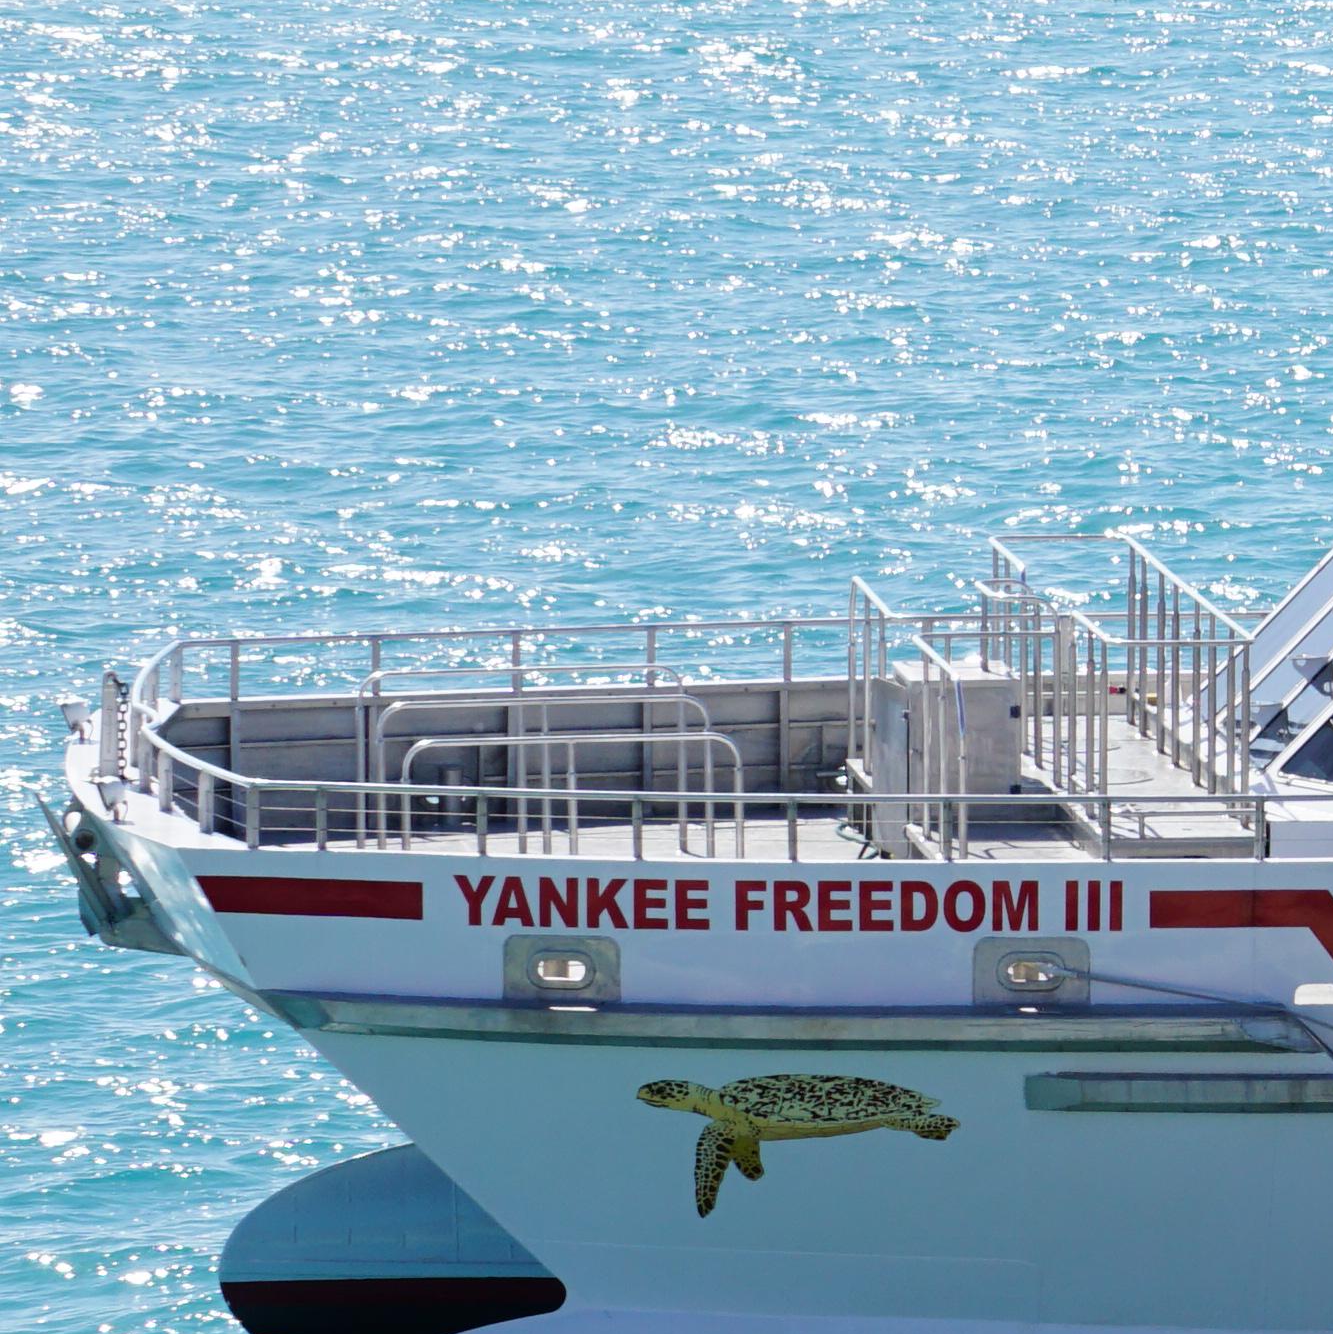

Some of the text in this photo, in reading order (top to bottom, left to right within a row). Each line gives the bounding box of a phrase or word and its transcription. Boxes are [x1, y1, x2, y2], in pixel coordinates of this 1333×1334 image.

[453, 874, 1123, 932] YANKEE FREEDOM III
